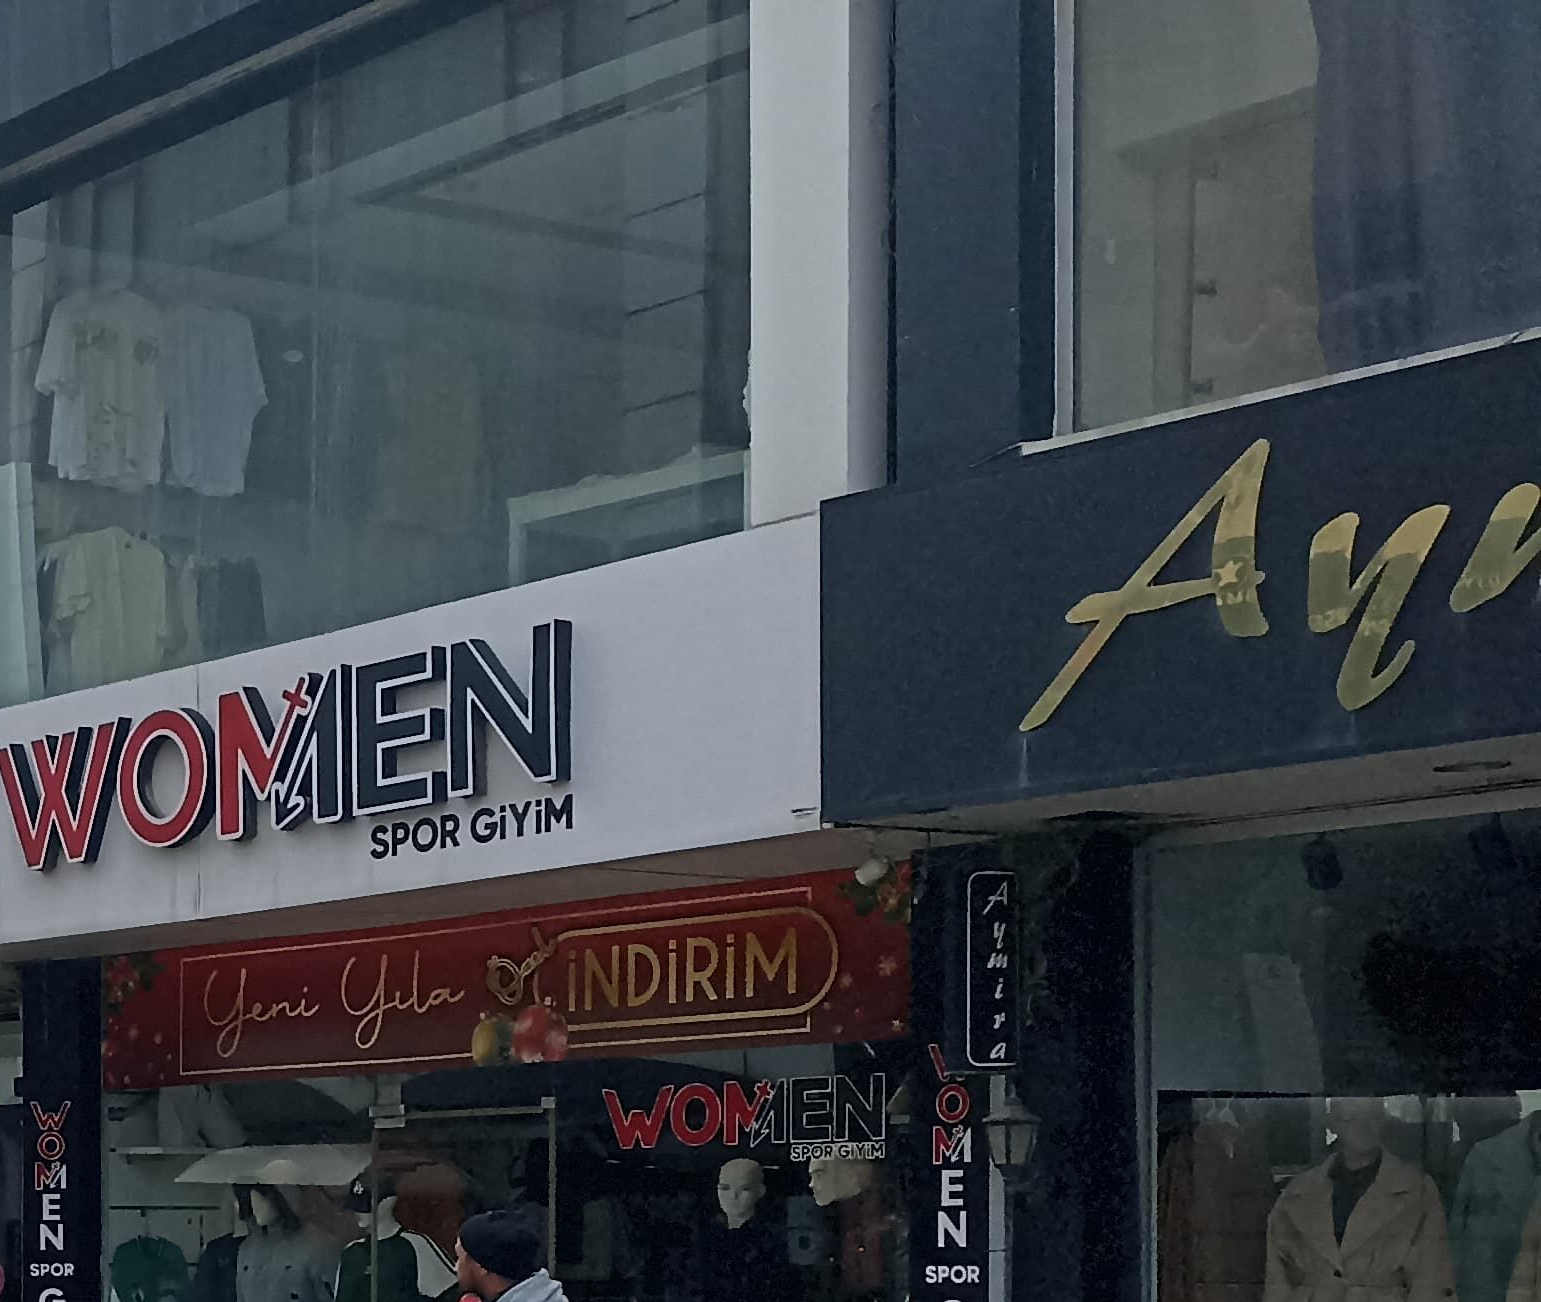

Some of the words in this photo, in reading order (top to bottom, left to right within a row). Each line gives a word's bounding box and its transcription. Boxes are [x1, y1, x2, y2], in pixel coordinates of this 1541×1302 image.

[370, 816, 461, 860] SPOR
[470, 793, 574, 844] GİYİM
[204, 966, 319, 1058] Yeni
[567, 927, 798, 1011] İNDİRİM
[982, 880, 1008, 1059] Aymira
[602, 1072, 886, 1150] WOMEN
[30, 1100, 70, 1251] WOMEN
[790, 1143, 833, 1161] SPOR
[29, 1262, 75, 1278] SPOR
[925, 1264, 980, 1284] SPOR
